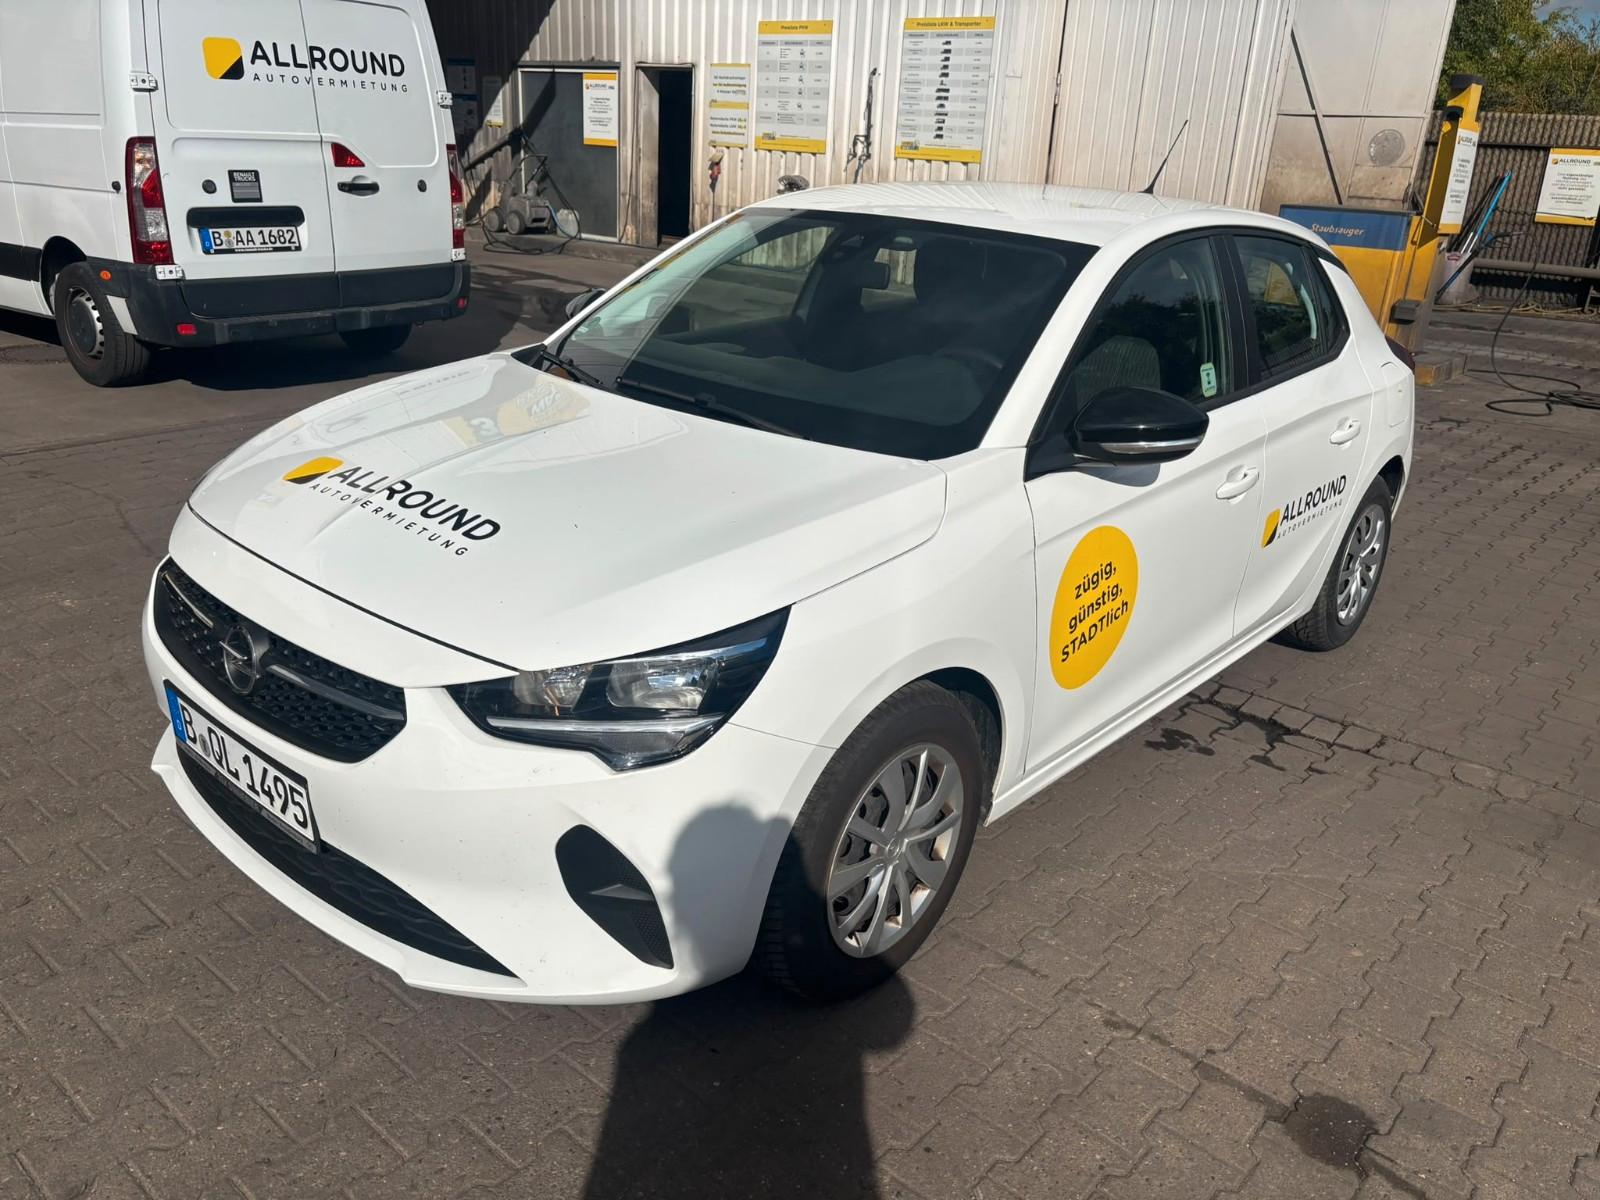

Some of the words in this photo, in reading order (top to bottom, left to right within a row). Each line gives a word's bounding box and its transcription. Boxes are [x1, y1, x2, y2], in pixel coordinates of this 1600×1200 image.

[250, 41, 405, 77] ALLROUND
[253, 73, 408, 93] AUTOVERMIETUNG
[211, 231, 223, 247] B
[235, 230, 256, 246] AA
[257, 229, 297, 246] 1682
[1311, 223, 1364, 237] Staubsauger
[309, 484, 468, 556] AUTOVERMIETUNG
[328, 466, 501, 541] ALLROUND
[1280, 475, 1346, 526] ALLROUND
[1074, 560, 1117, 600] zügig,
[1060, 600, 1129, 663] STADTlich
[1068, 582, 1123, 634] günstig,
[179, 703, 197, 744] B
[207, 726, 240, 782] QL
[242, 753, 308, 829] 1495
